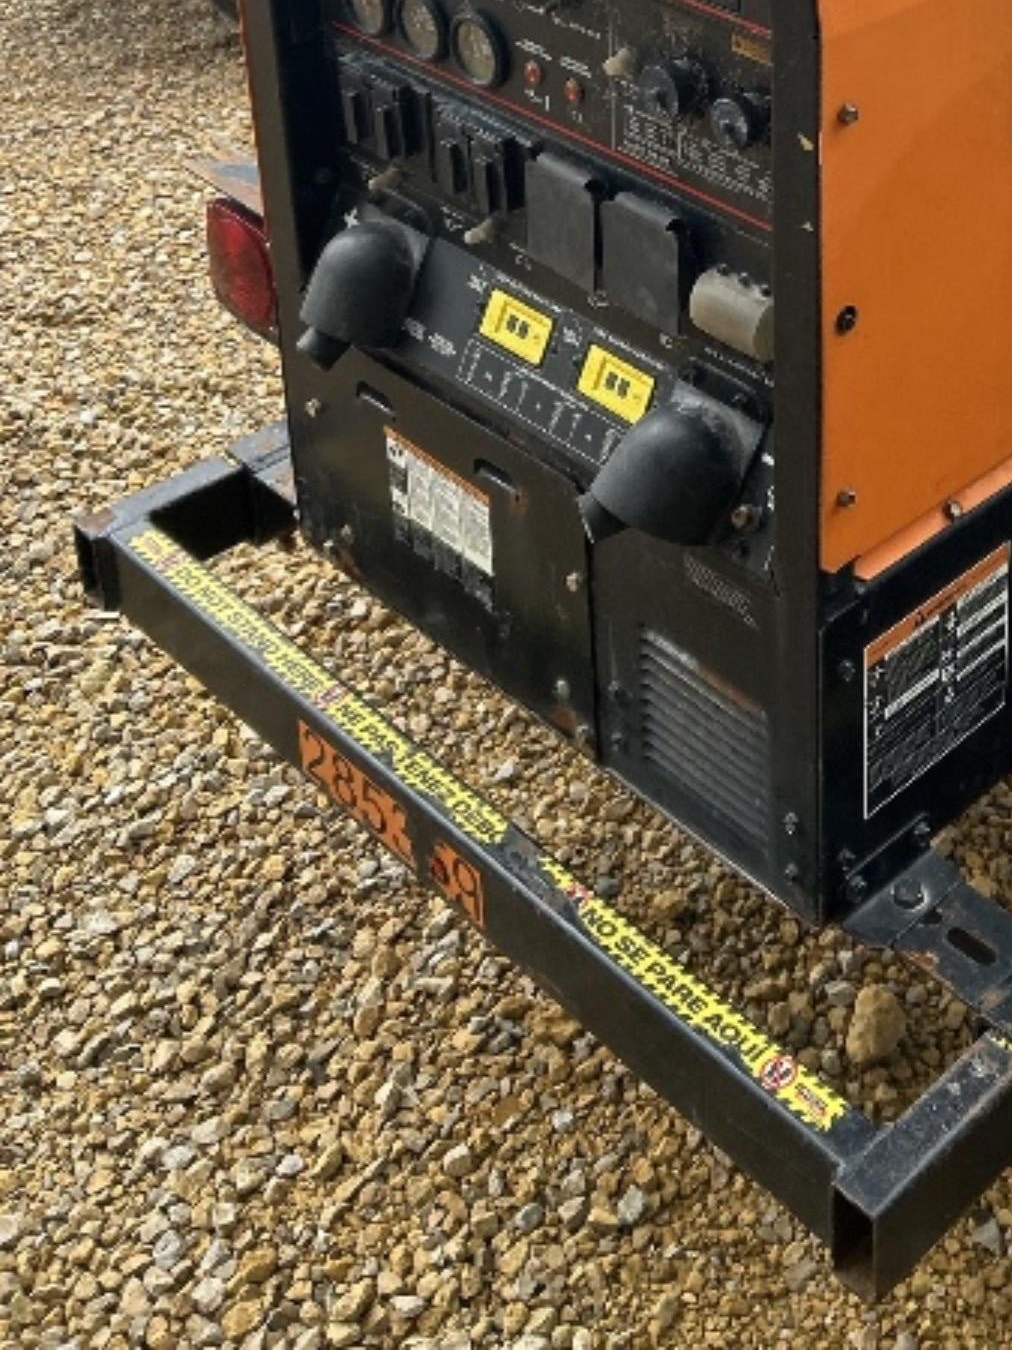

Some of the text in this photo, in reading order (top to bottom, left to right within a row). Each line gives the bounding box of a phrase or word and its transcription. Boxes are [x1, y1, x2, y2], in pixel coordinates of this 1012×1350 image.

[175, 566, 324, 690] DO NOT STAND HERE
[580, 907, 619, 938] NO
[613, 936, 651, 965] SE
[644, 961, 709, 1016] PARE
